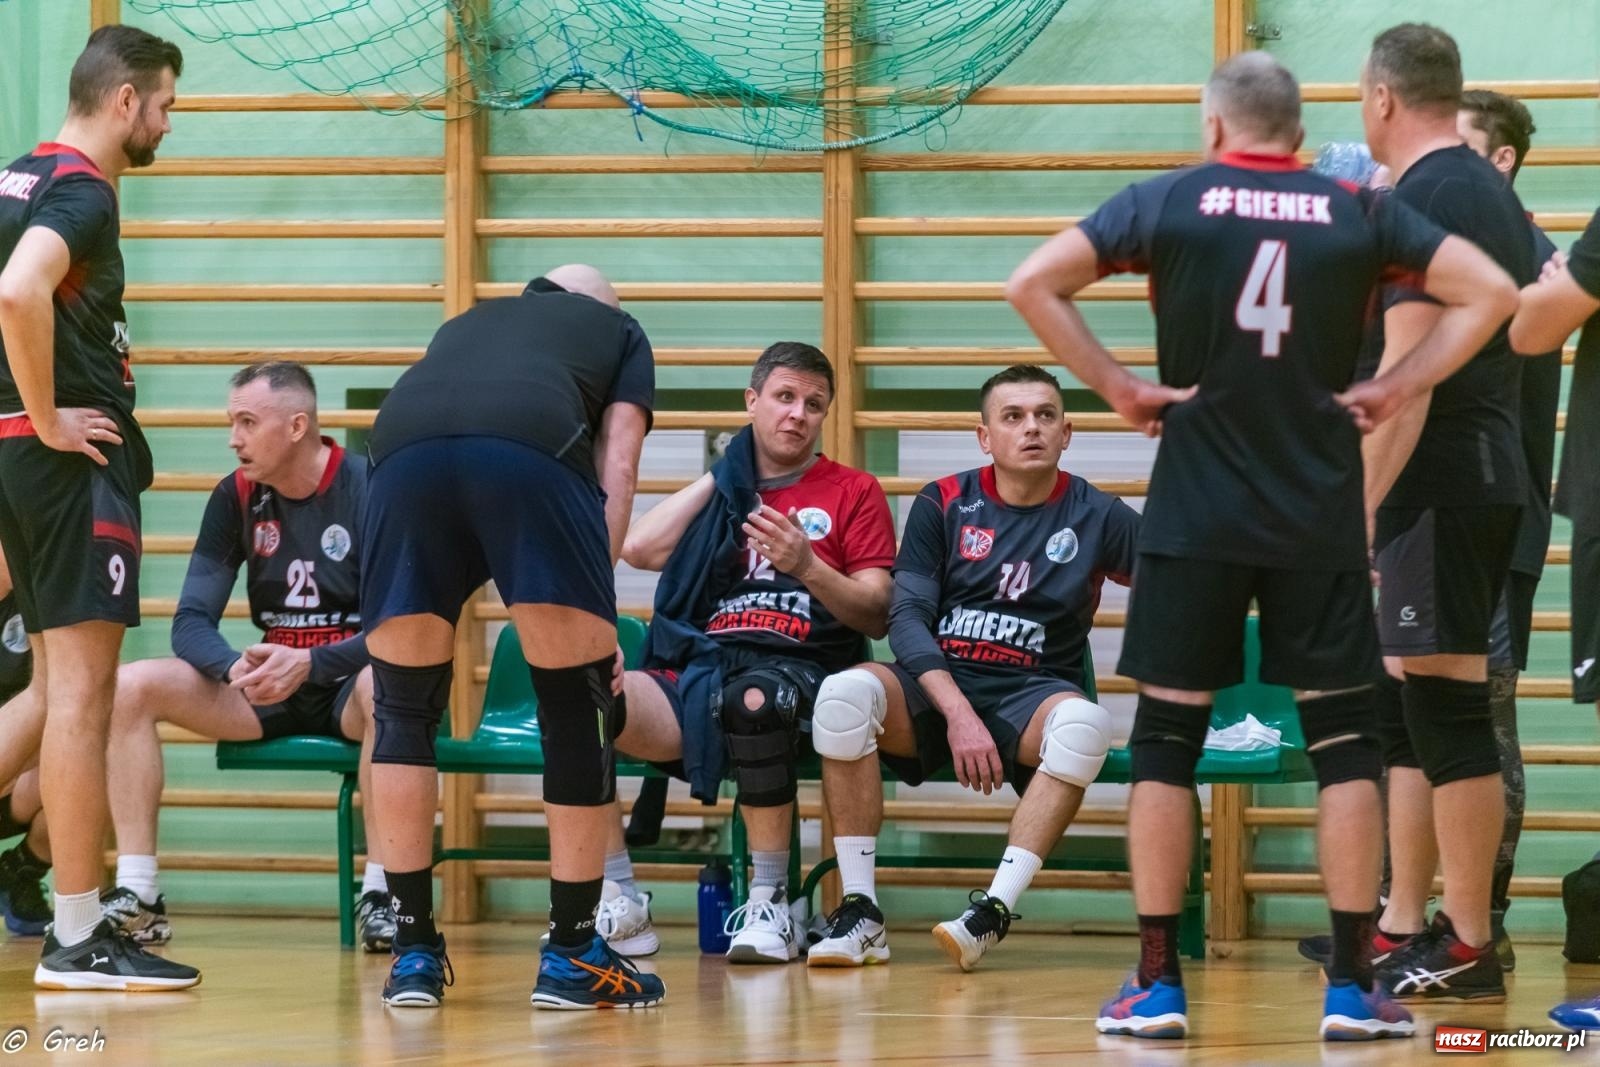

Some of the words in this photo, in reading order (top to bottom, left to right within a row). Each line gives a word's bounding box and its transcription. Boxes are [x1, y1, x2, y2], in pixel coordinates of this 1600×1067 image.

[1199, 186, 1333, 225] #GIENEK
[1235, 239, 1293, 357] 4
[108, 553, 126, 595] 9
[283, 558, 321, 608] 25
[992, 560, 1031, 601] 14
[266, 627, 355, 649] ORTHER
[938, 603, 1045, 654] OMERTA
